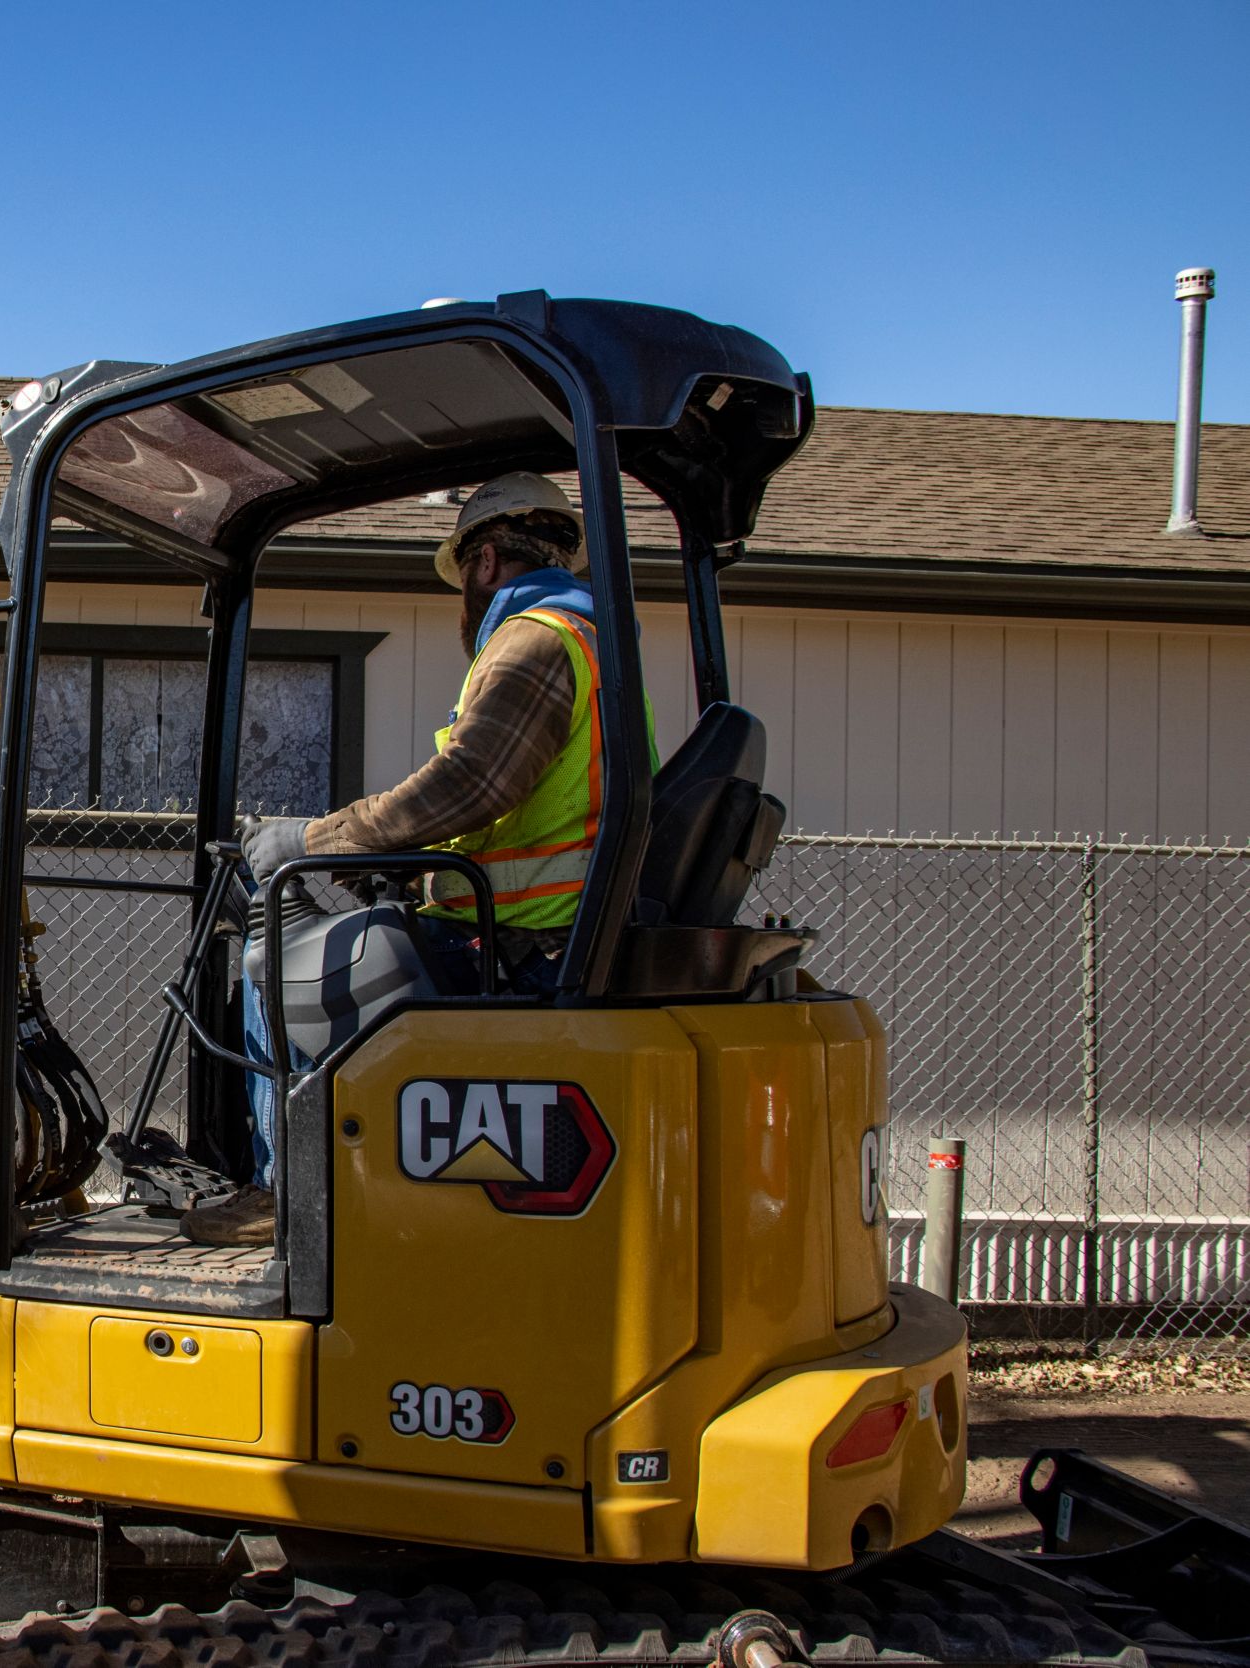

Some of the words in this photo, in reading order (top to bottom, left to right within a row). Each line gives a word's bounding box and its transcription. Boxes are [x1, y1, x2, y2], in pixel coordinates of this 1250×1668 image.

[401, 1081, 558, 1183] CAT
[391, 1383, 484, 1439] 303
[627, 1456, 660, 1479] CR
